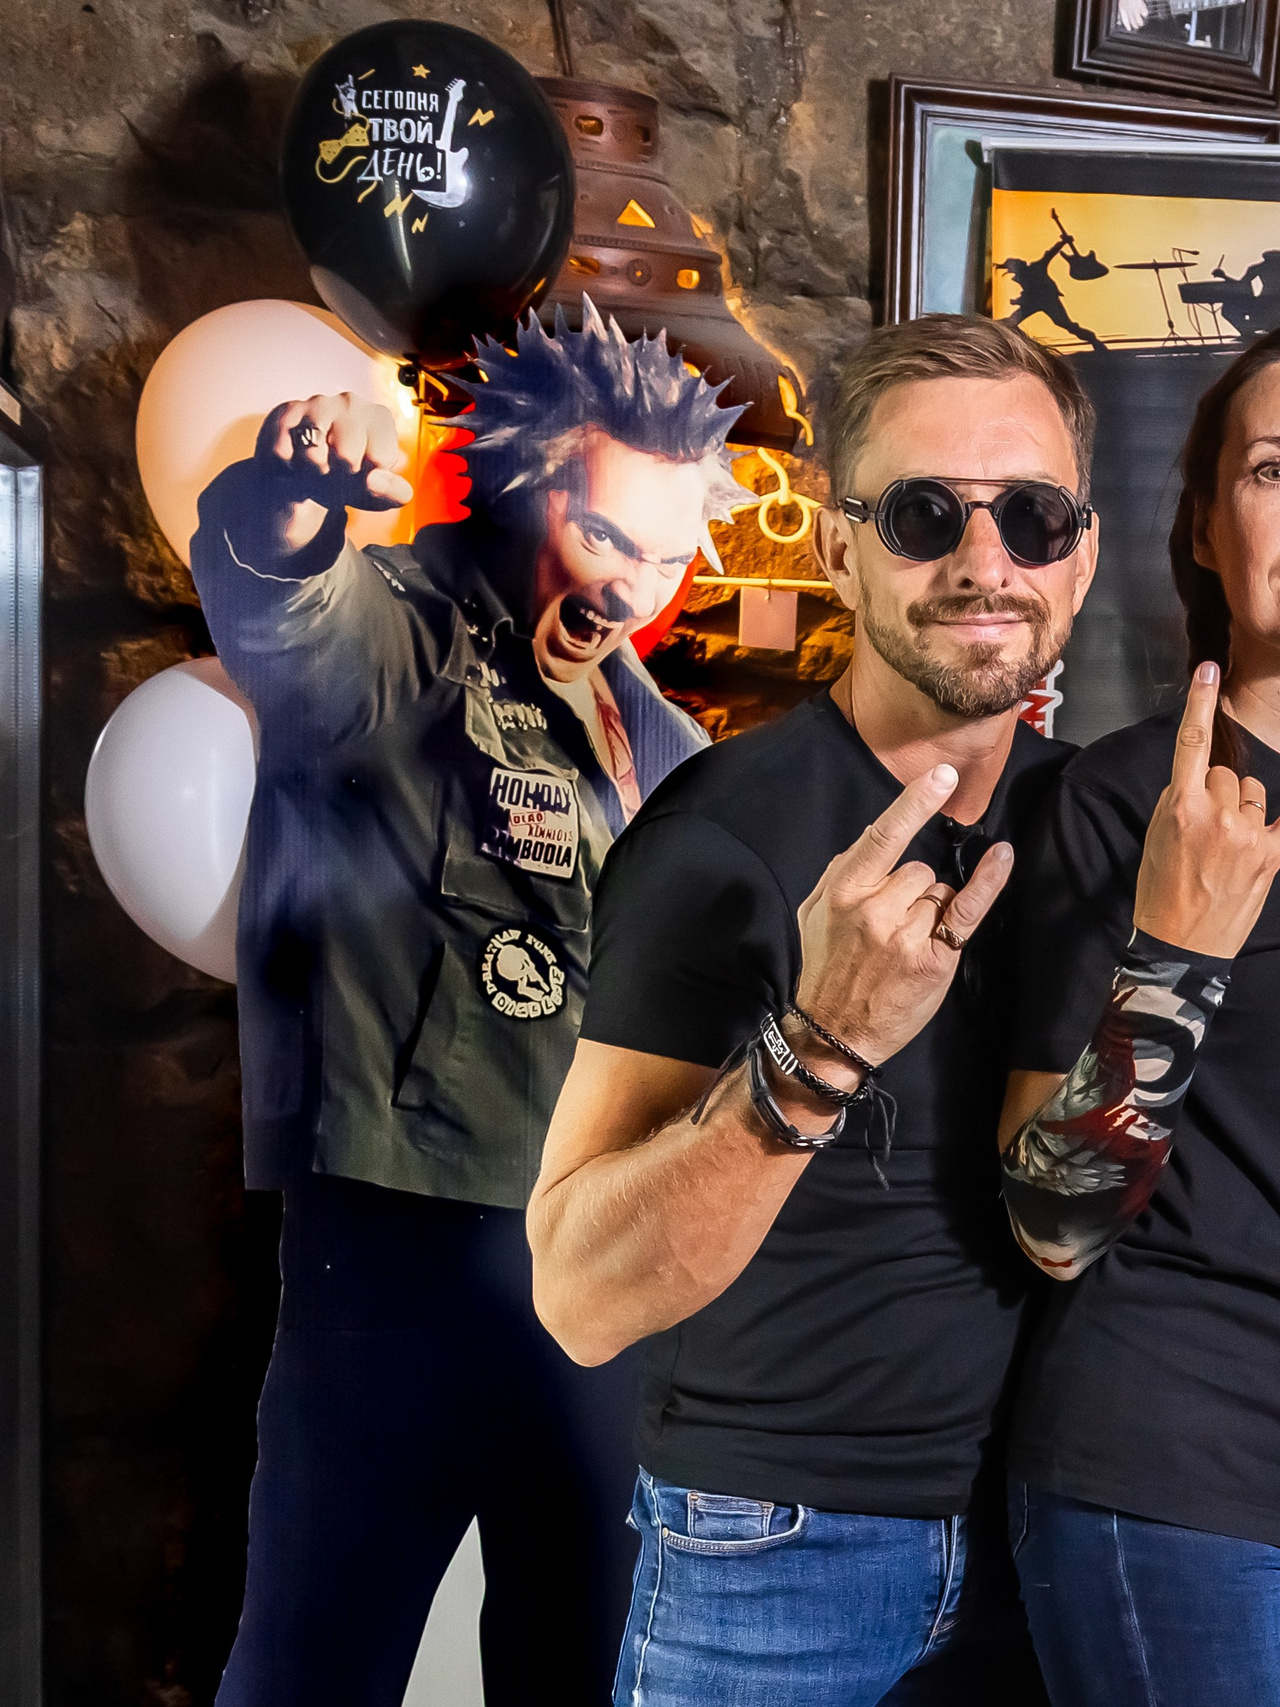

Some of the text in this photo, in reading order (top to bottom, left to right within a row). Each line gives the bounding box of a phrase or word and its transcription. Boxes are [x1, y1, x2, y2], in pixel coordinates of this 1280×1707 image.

[361, 90, 439, 112] СЕГОДНЯ
[369, 115, 434, 144] ТВОЙ
[356, 148, 442, 184] ДЕНЬ!
